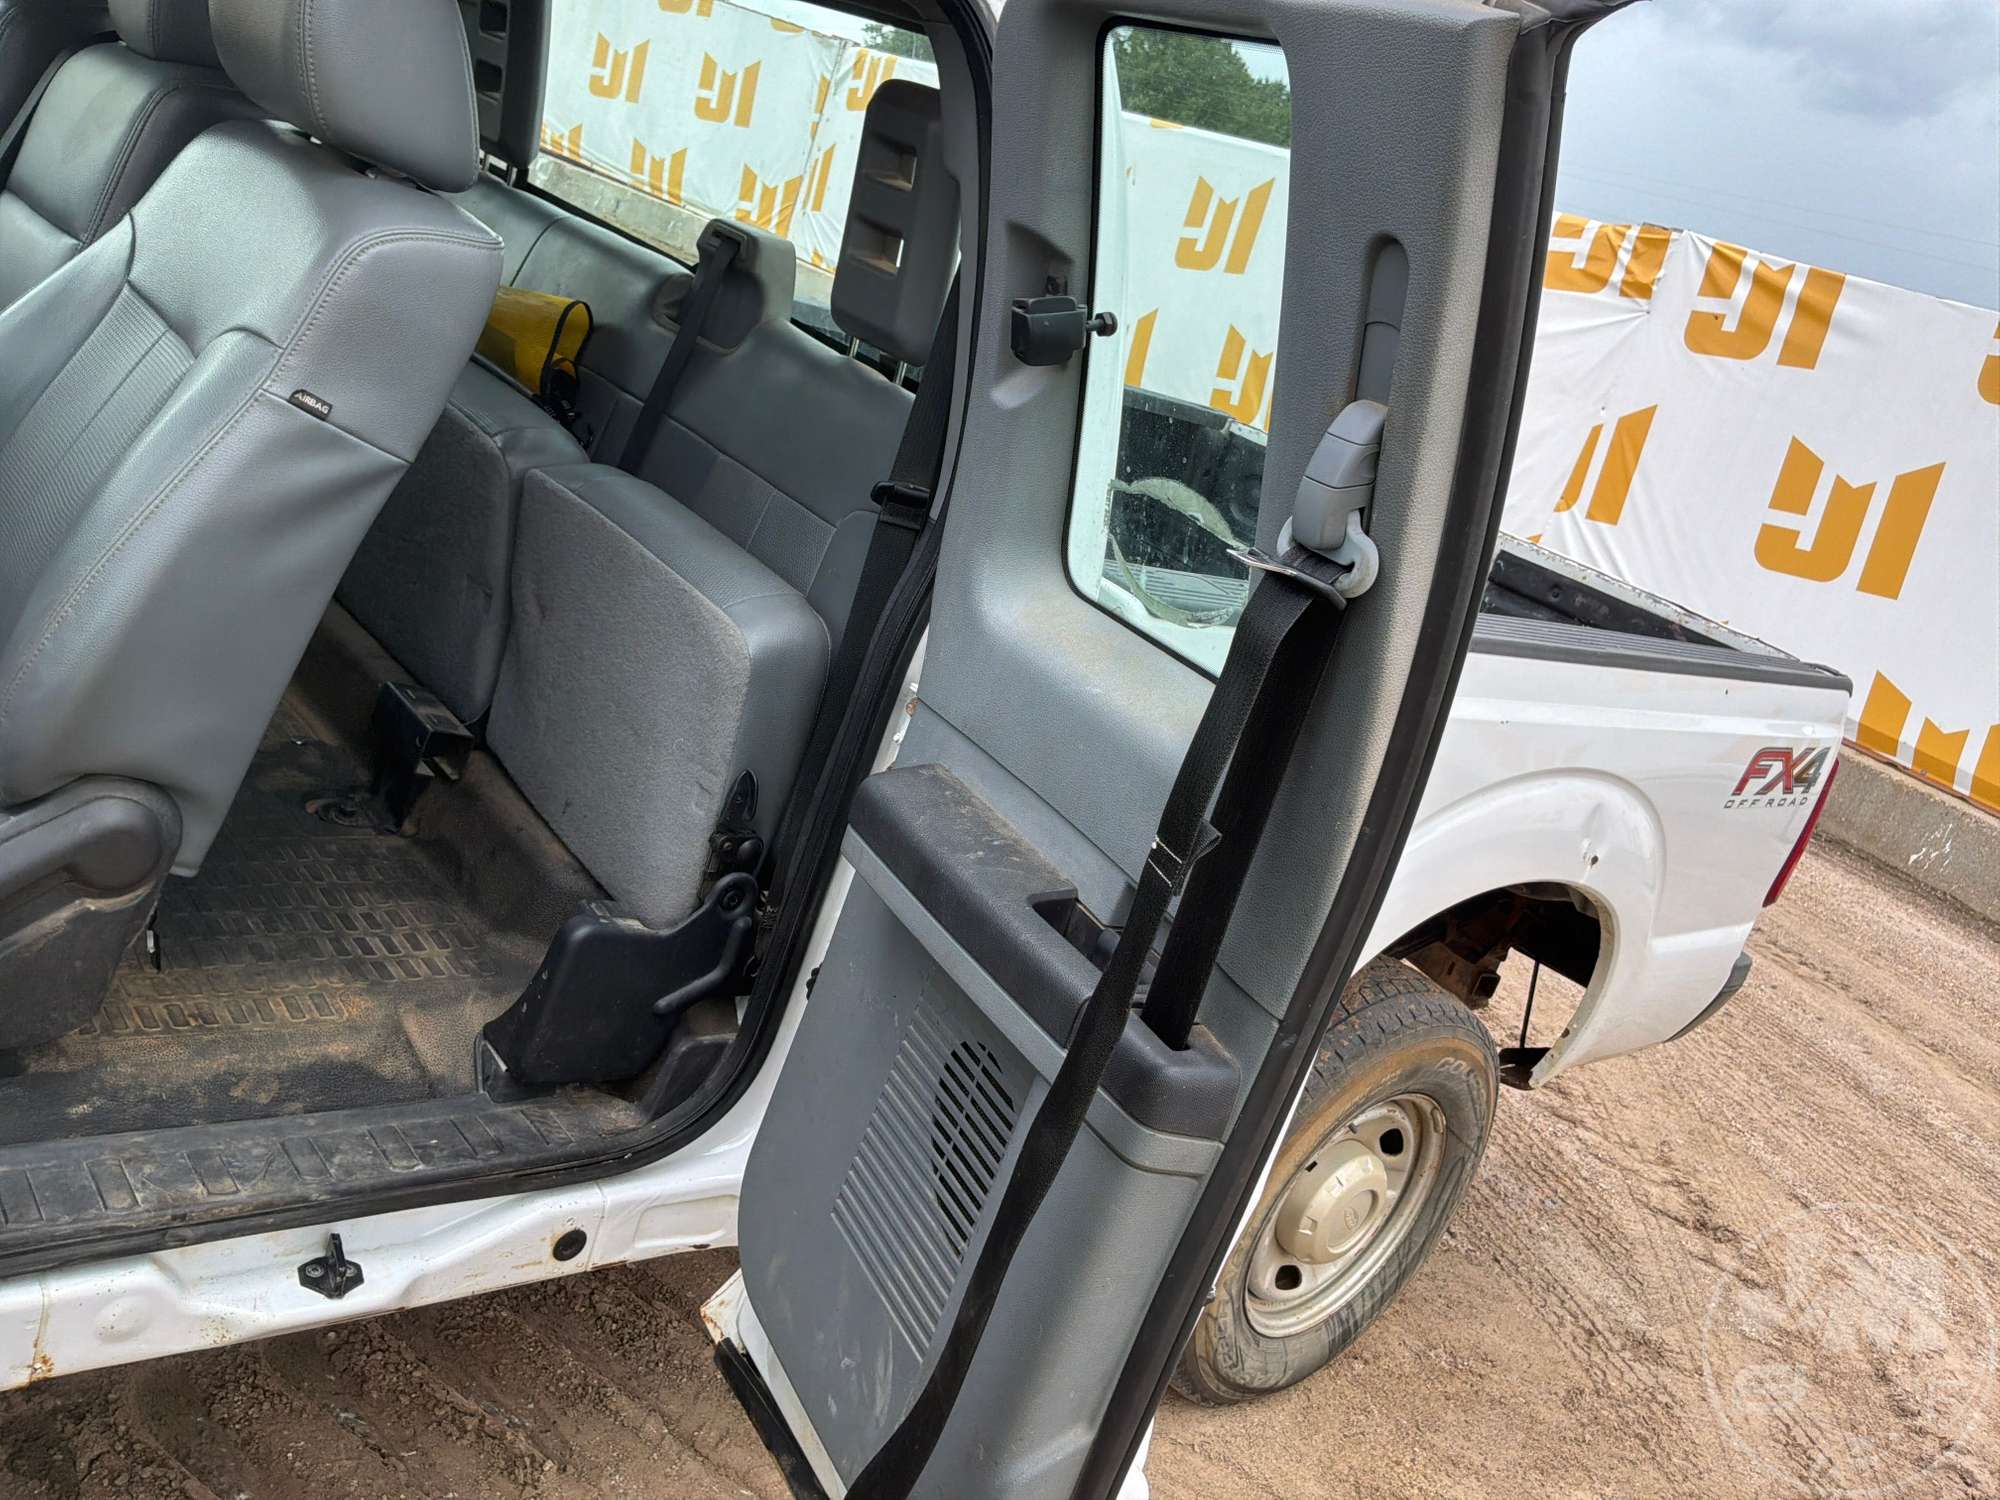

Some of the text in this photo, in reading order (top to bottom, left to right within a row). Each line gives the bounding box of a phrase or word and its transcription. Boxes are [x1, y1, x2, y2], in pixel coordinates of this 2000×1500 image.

[293, 391, 331, 415] AIRBAG
[1731, 746, 1832, 796] FX4
[1723, 796, 1809, 809] OFF ROAD
